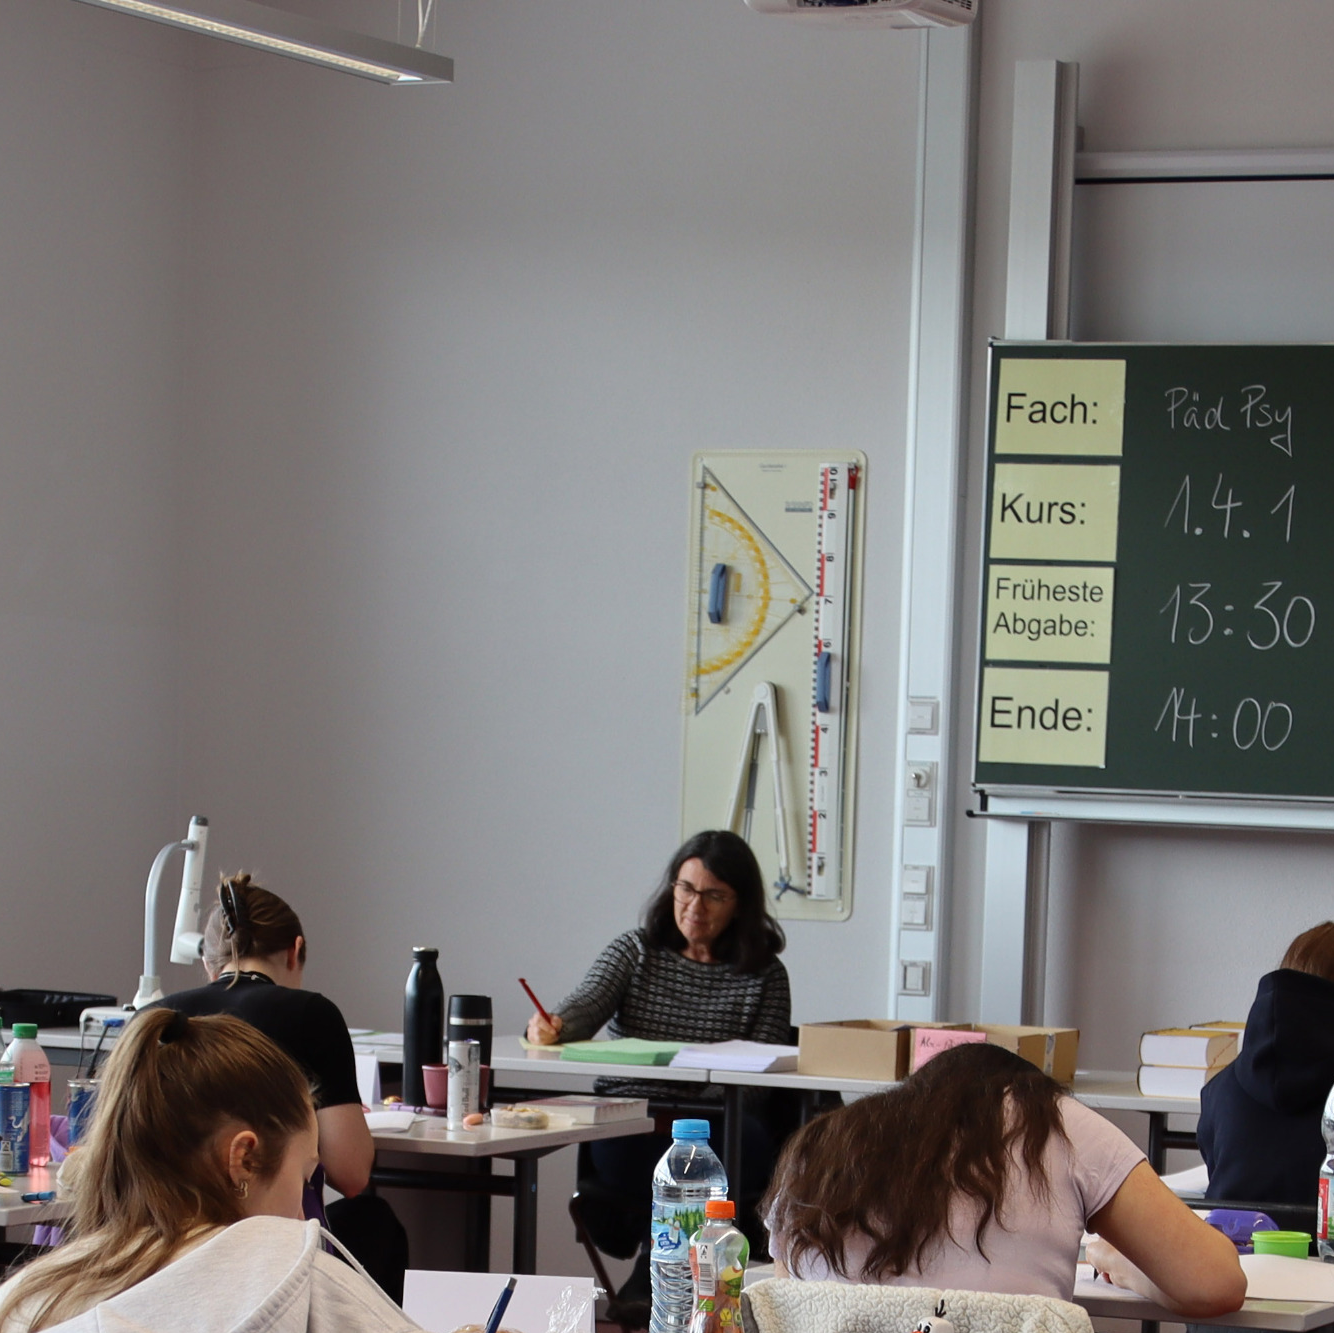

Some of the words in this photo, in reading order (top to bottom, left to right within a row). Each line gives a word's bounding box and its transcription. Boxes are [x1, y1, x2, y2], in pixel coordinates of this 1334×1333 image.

[1006, 393, 1098, 425] Fach:
[1164, 386, 1230, 430] Päd
[1240, 384, 1292, 457] Psy
[999, 492, 1086, 525] Kurs:
[995, 577, 1104, 604] Früheste
[993, 612, 1095, 642] Abgabe:
[1160, 581, 1316, 651] 13:30
[990, 696, 1093, 733] Ende:
[1155, 687, 1293, 751] 14:00
